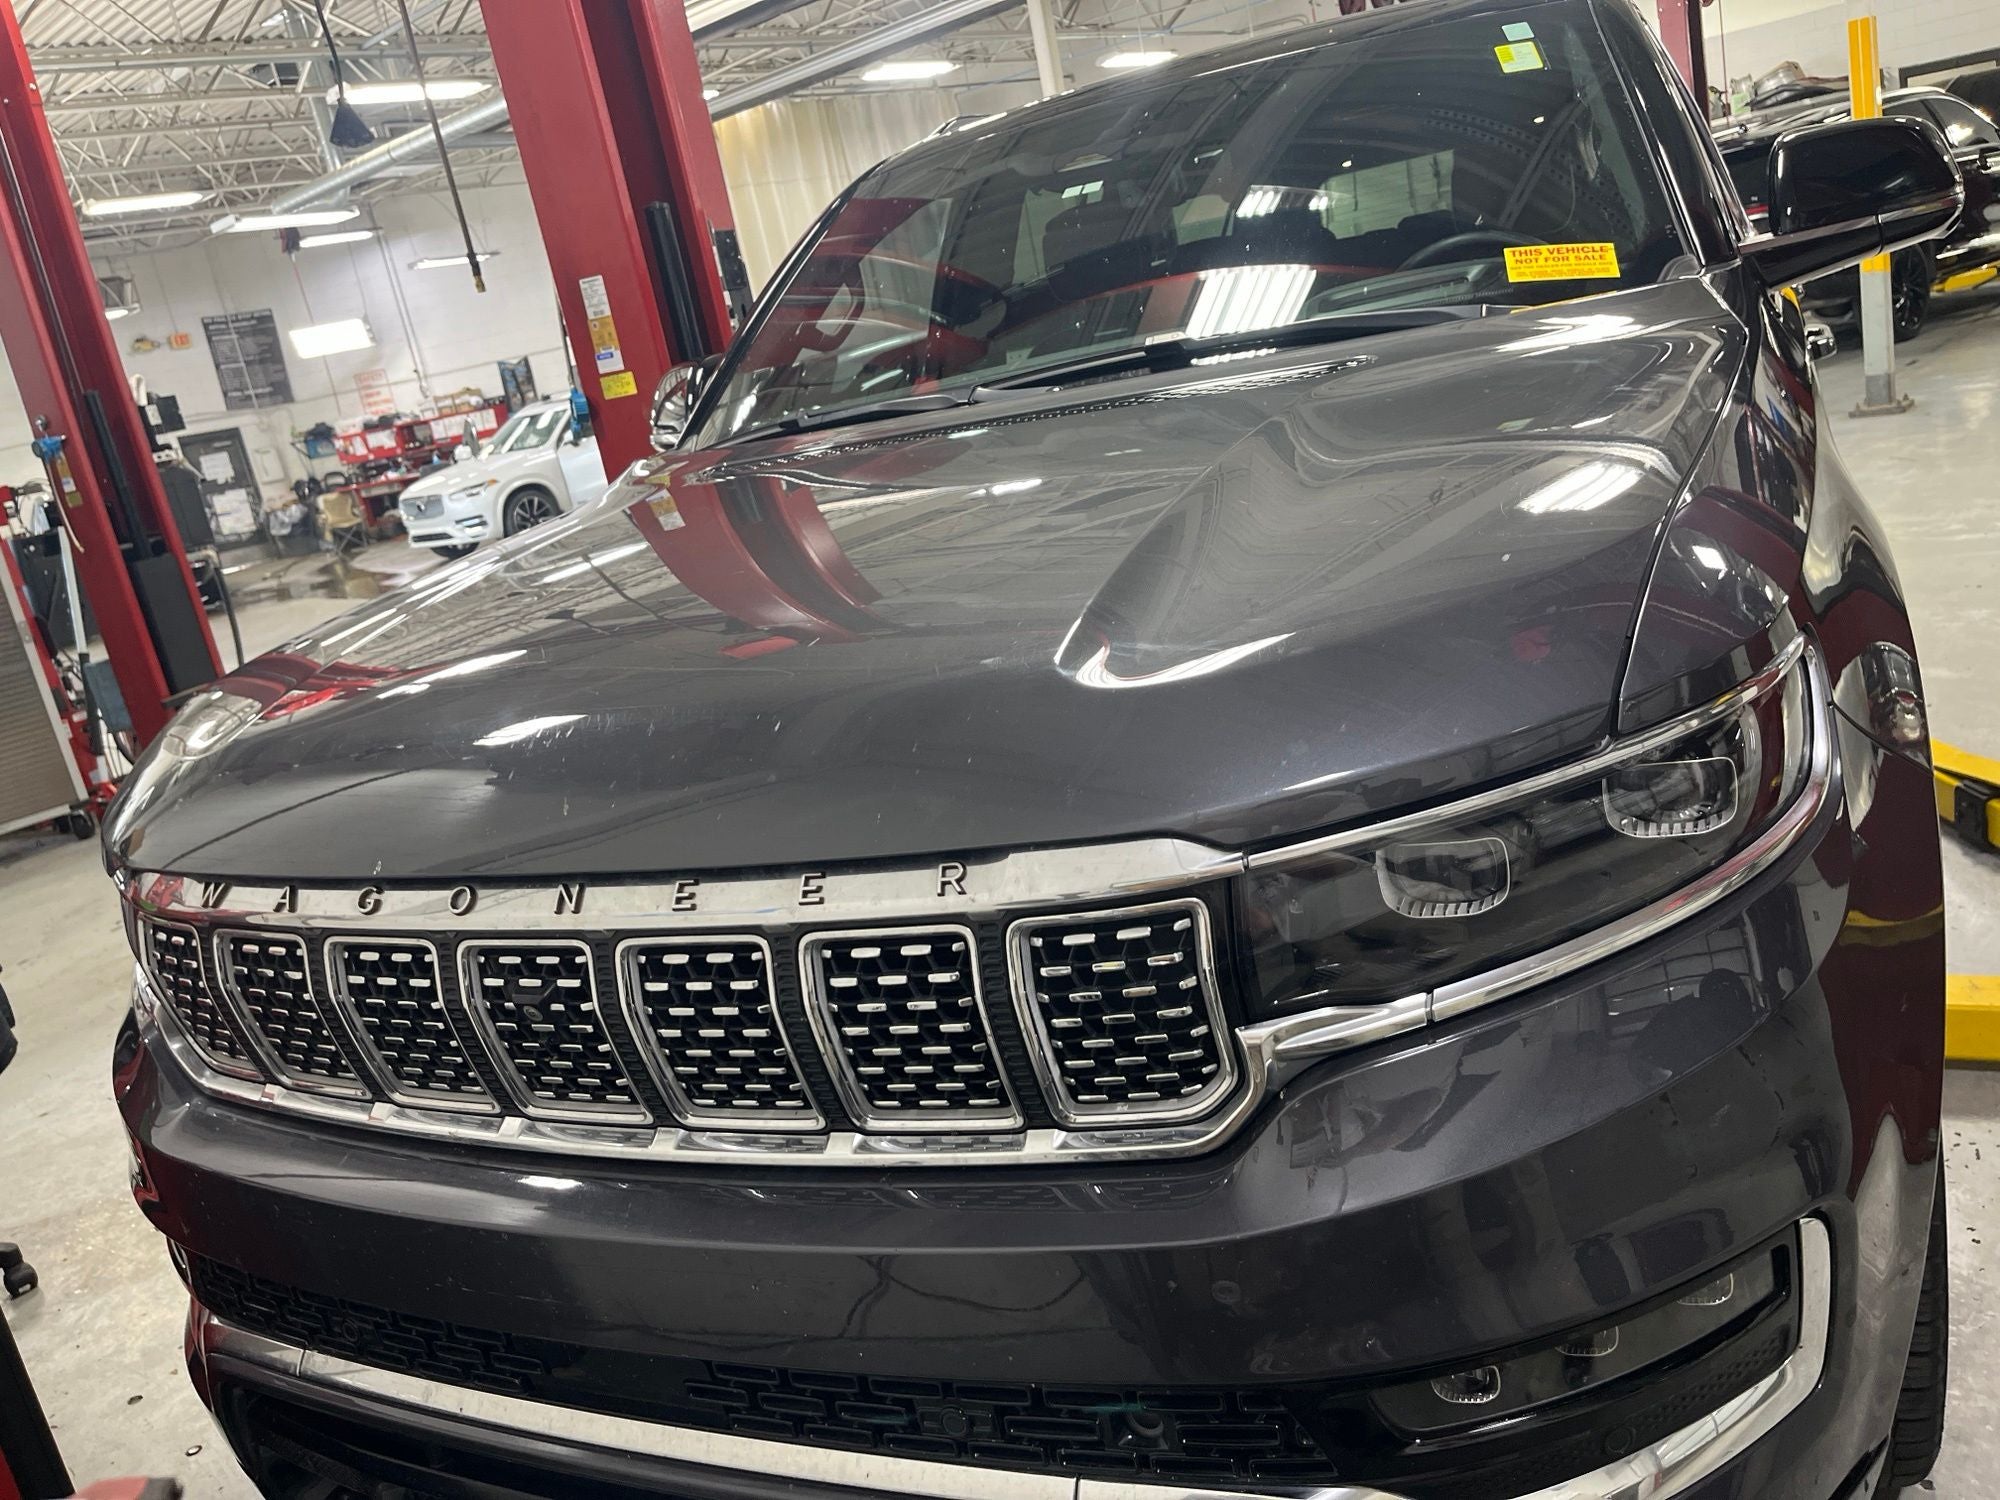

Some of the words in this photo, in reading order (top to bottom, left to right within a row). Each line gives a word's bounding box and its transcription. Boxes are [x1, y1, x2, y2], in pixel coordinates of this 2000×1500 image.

[1510, 249, 1543, 258] THIS
[1546, 245, 1609, 255] VEHICLE
[1515, 257, 1540, 265] NOT
[1544, 256, 1570, 264] FOR
[1574, 254, 1608, 262] SALE
[200, 861, 968, 916] WAGONEER
